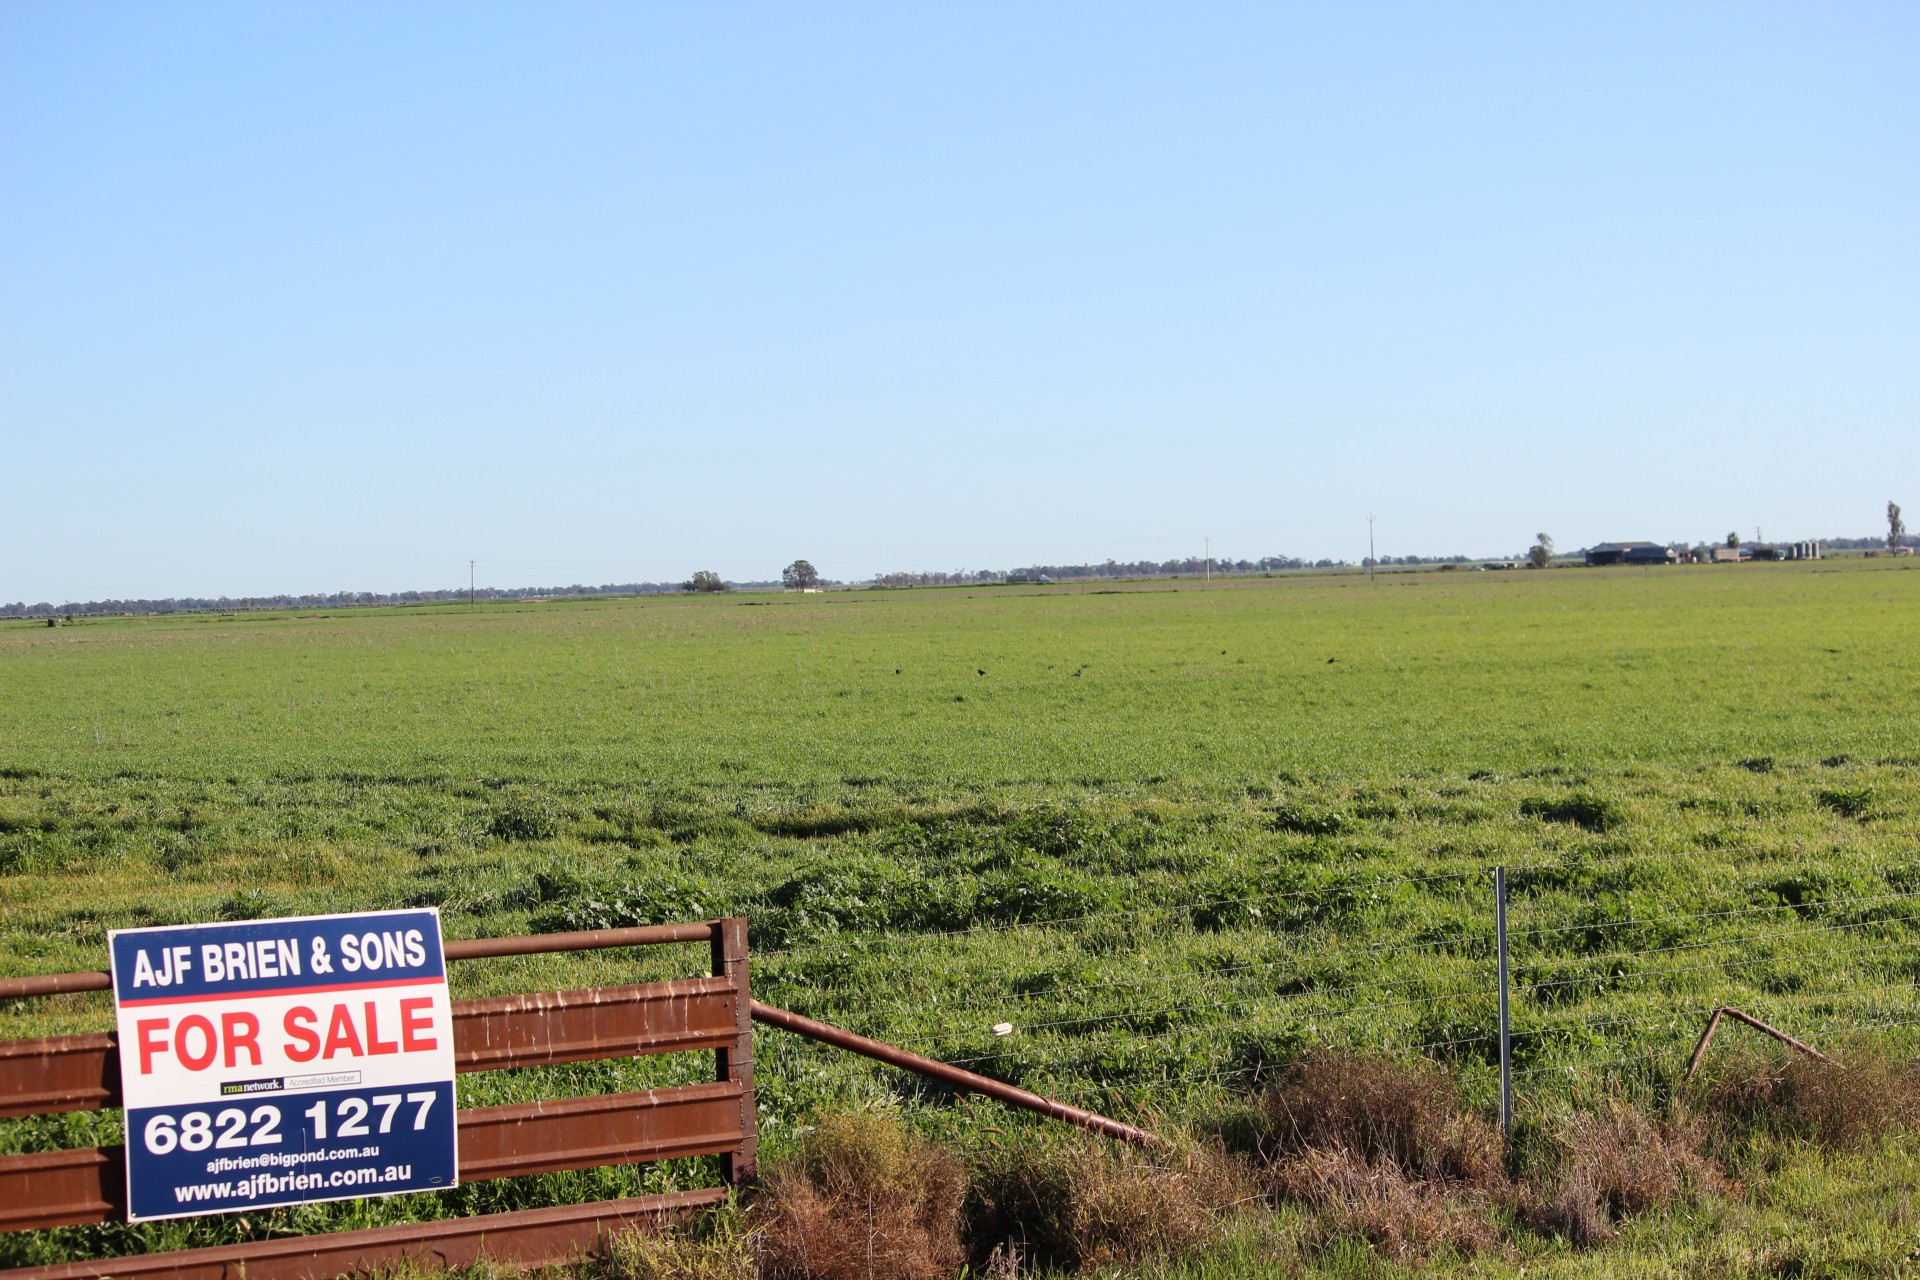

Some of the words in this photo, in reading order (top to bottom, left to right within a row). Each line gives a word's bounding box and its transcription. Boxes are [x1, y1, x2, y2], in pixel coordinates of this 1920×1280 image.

[133, 946, 191, 988] AJF
[201, 938, 301, 982] BRIEN
[311, 936, 334, 974] &
[340, 929, 426, 972] SONS
[137, 1011, 263, 1075] FOR
[283, 996, 437, 1062] SALE
[289, 1076, 325, 1087] Accredited
[326, 1074, 355, 1084] Member
[144, 1105, 283, 1155] 6822
[305, 1091, 437, 1140] 1277
[174, 1164, 412, 1203] www.ajfbrien.com.au
[207, 1145, 379, 1174] ajfbrien@bigpond.com.au
